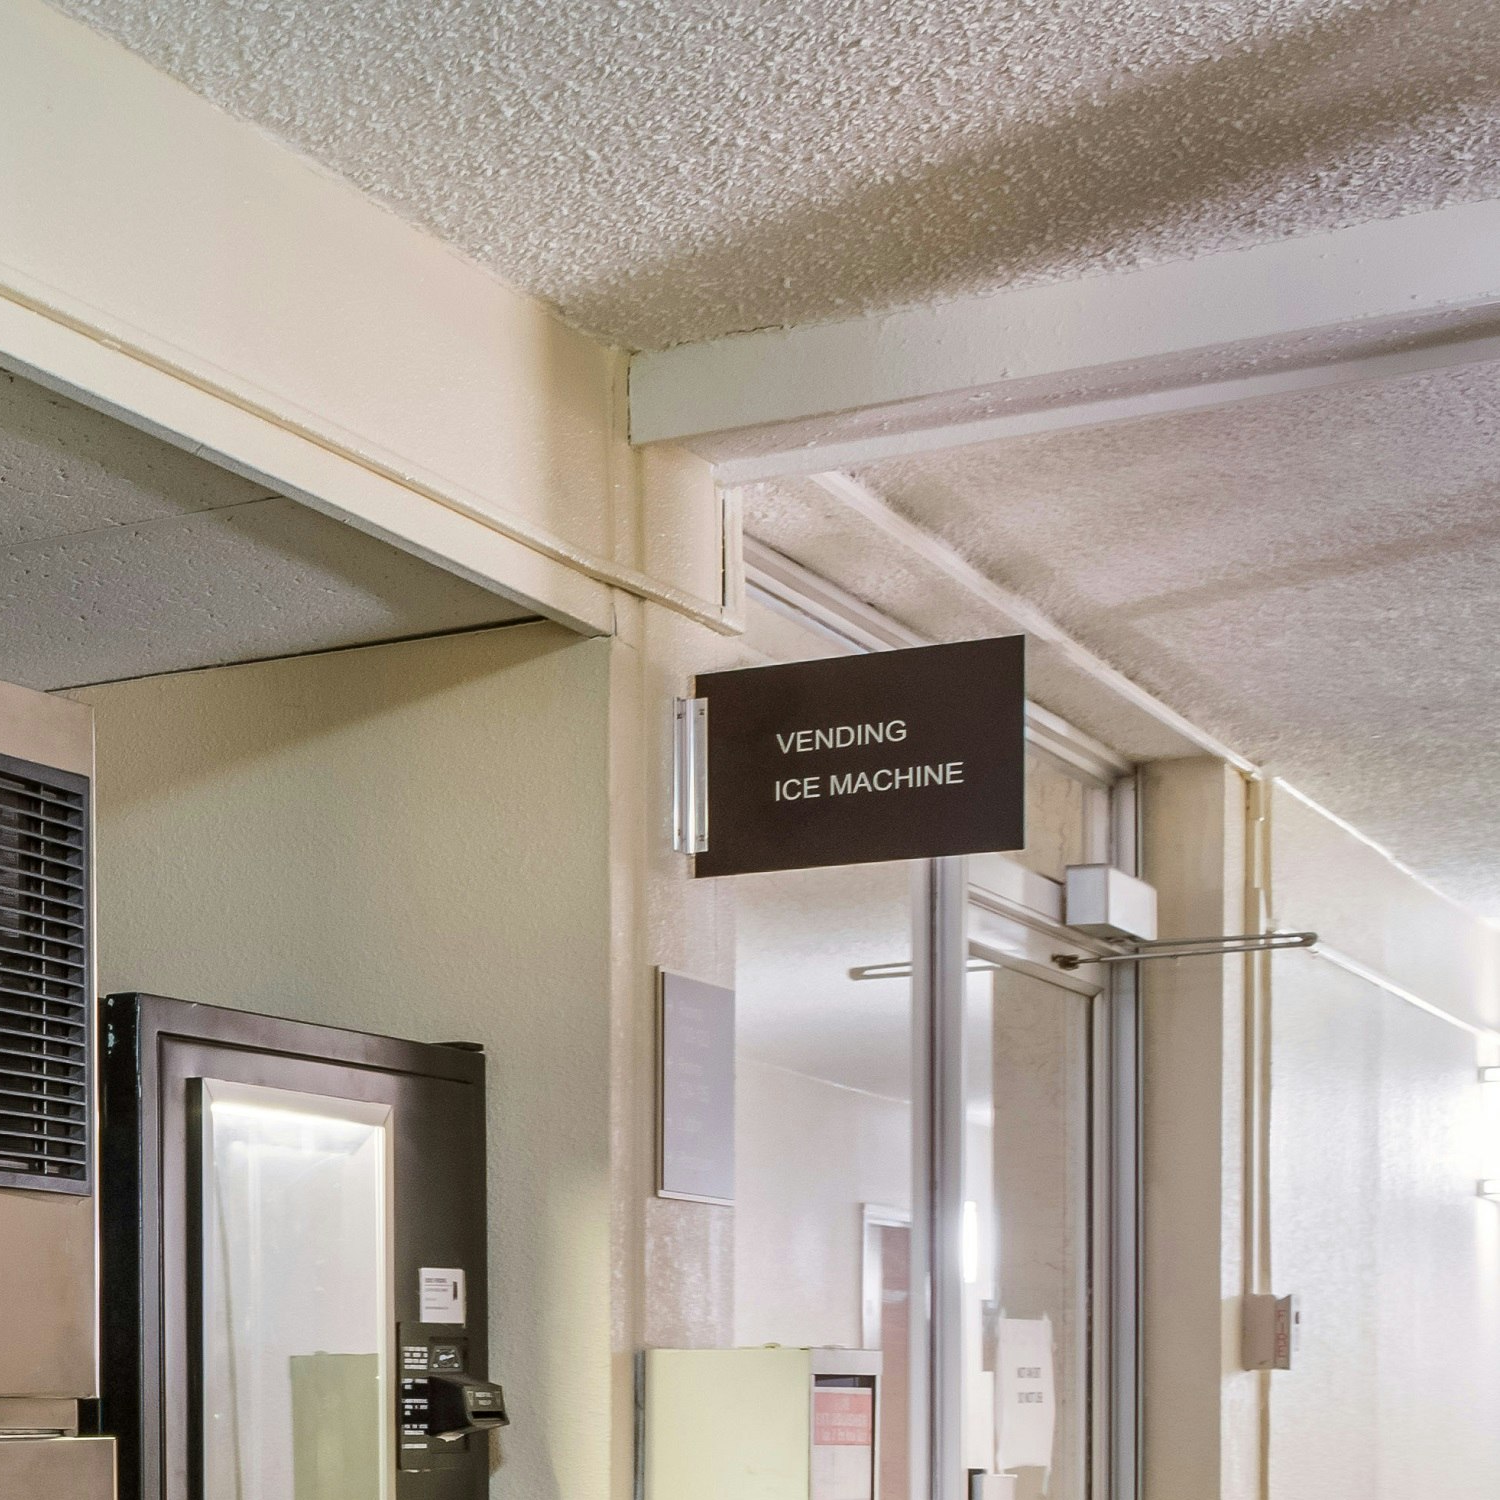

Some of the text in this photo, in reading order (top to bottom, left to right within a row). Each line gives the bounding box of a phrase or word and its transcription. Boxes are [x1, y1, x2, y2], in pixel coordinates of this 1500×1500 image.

[776, 720, 907, 754] VENDING
[775, 761, 965, 801] ICE MACHINE
